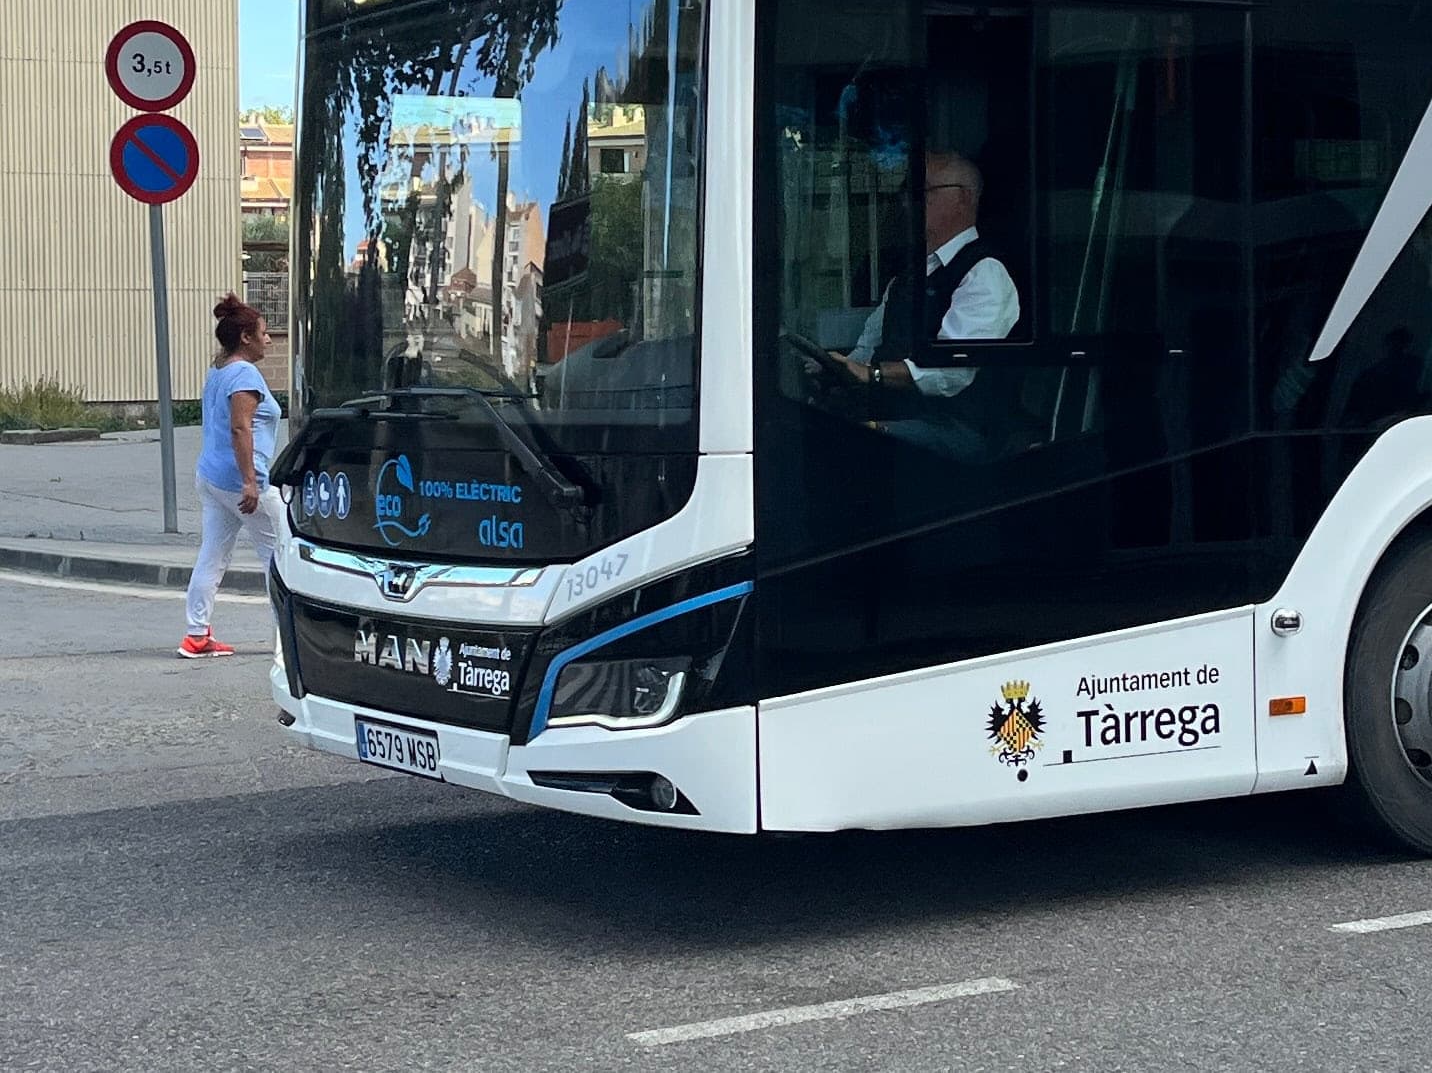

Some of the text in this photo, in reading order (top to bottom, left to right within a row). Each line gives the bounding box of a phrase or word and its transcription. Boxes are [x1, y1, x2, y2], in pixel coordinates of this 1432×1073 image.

[376, 494, 401, 517] eco
[418, 479, 522, 503] 100% ELÈCTRIC
[479, 514, 524, 549] alsa
[566, 554, 628, 601] 13047
[354, 629, 431, 675] MAN
[501, 647, 512, 661] de
[458, 660, 510, 695] Tàrrega
[1077, 664, 1219, 701] Ajuntament de
[1076, 703, 1220, 747] Tàrrega
[367, 728, 437, 772] 6579 MSB
